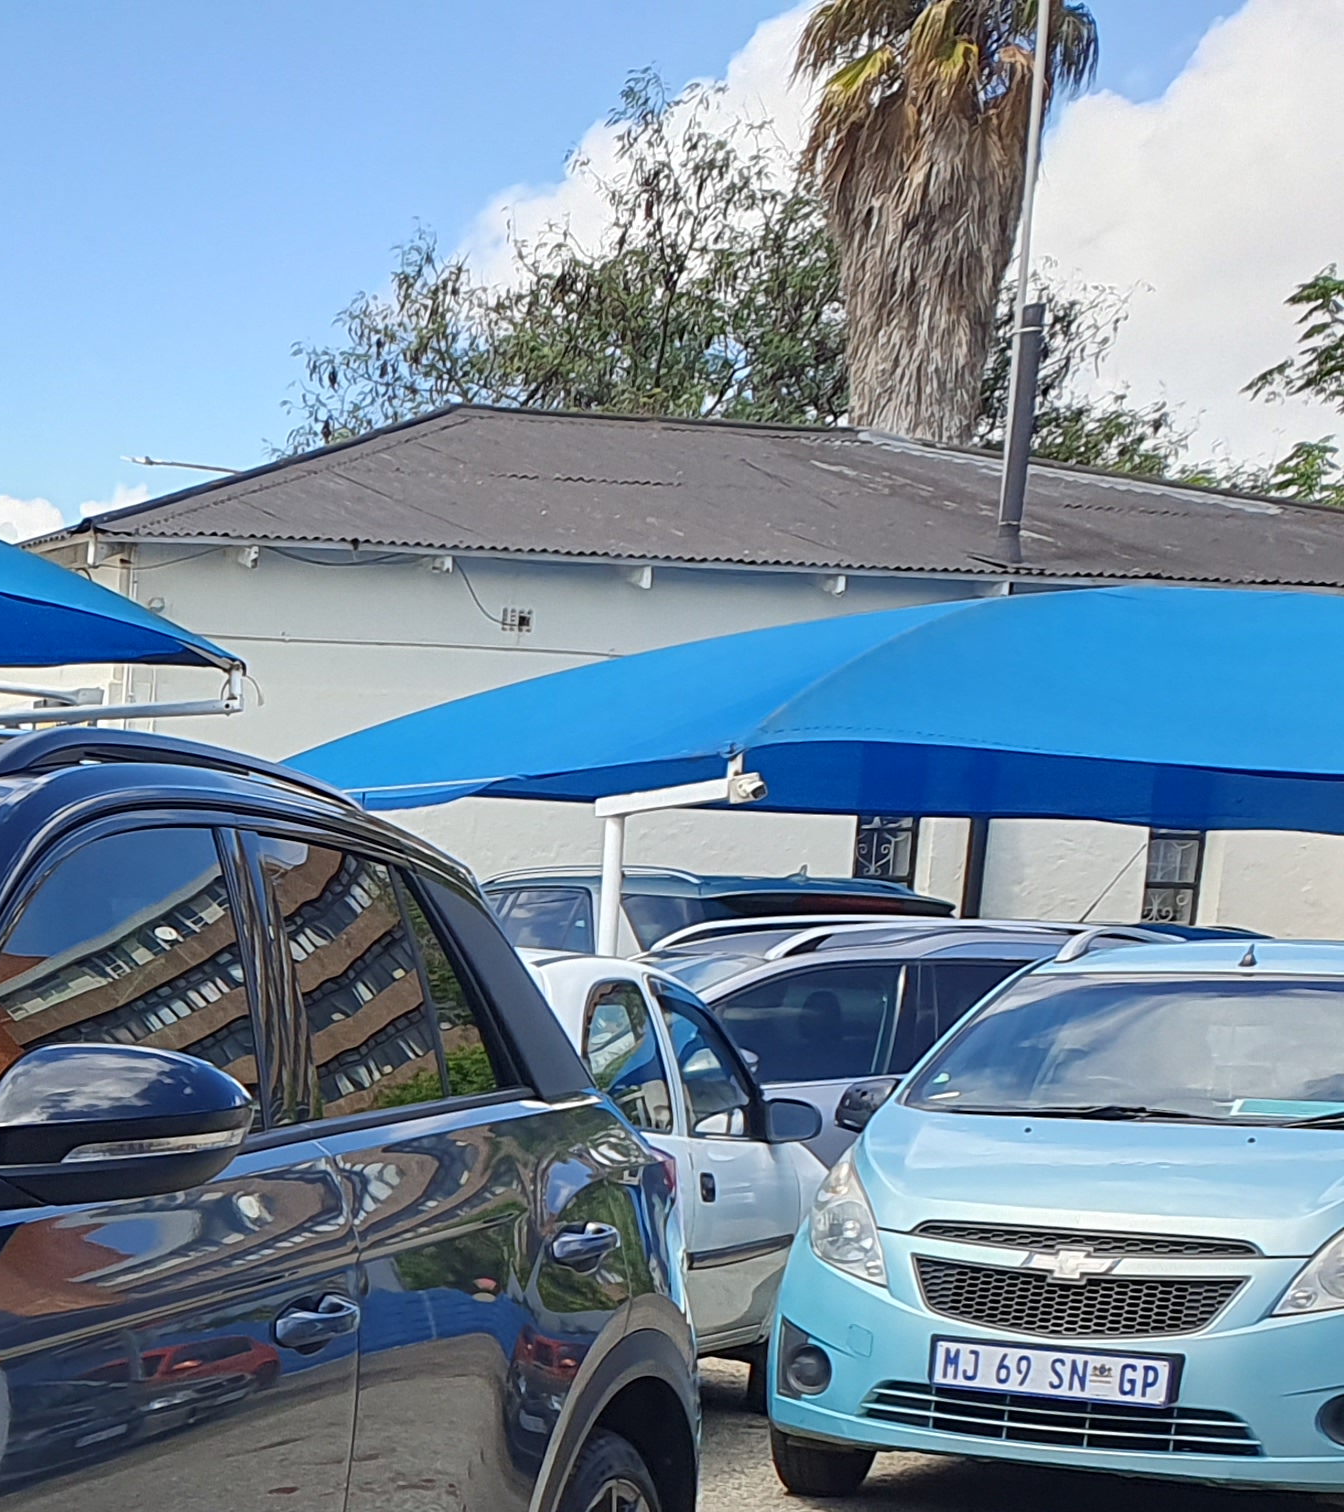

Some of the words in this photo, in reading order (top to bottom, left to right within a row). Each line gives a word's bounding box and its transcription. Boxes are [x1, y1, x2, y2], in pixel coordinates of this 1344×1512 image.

[942, 1347, 980, 1382] MJ
[995, 1353, 1032, 1386] 69
[1048, 1358, 1089, 1392] SN
[1118, 1364, 1160, 1398] GP
